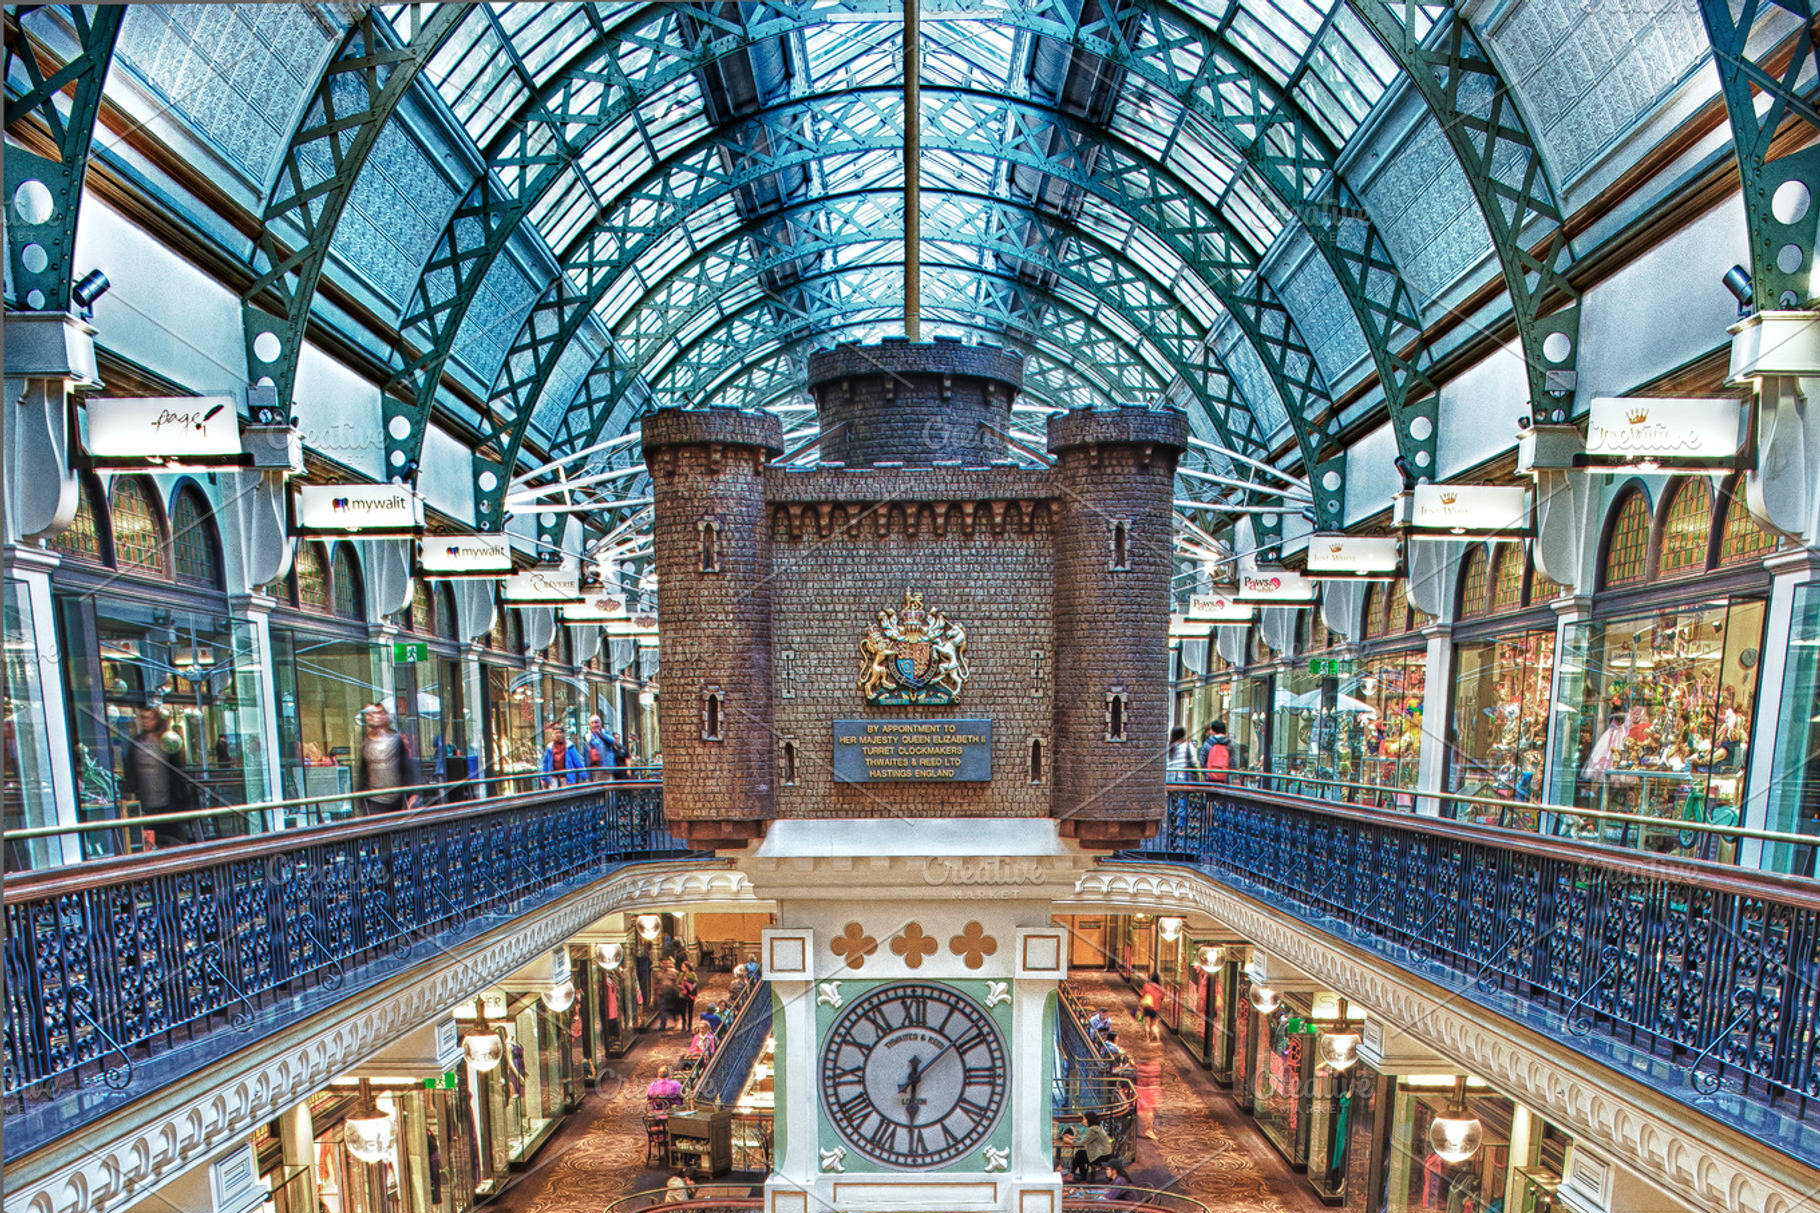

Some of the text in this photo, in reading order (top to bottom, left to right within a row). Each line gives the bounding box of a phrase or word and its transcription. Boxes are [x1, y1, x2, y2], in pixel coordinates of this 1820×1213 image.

[352, 496, 406, 514] mywalit
[462, 546, 505, 559] mywalit
[866, 724, 956, 734] BY APPOINTMENT TO
[838, 736, 857, 744] HER
[858, 736, 899, 744] MAJESTY
[901, 736, 931, 744] QUEEN
[932, 736, 979, 744] ELIZABETH
[862, 746, 963, 756] TURRET CLOCKMAKERS
[864, 758, 962, 767] THWAITES & REED LTD
[869, 769, 955, 778] HASTINGS ENGLAND
[901, 999, 927, 1026] XII
[901, 1098, 927, 1106] LODON
